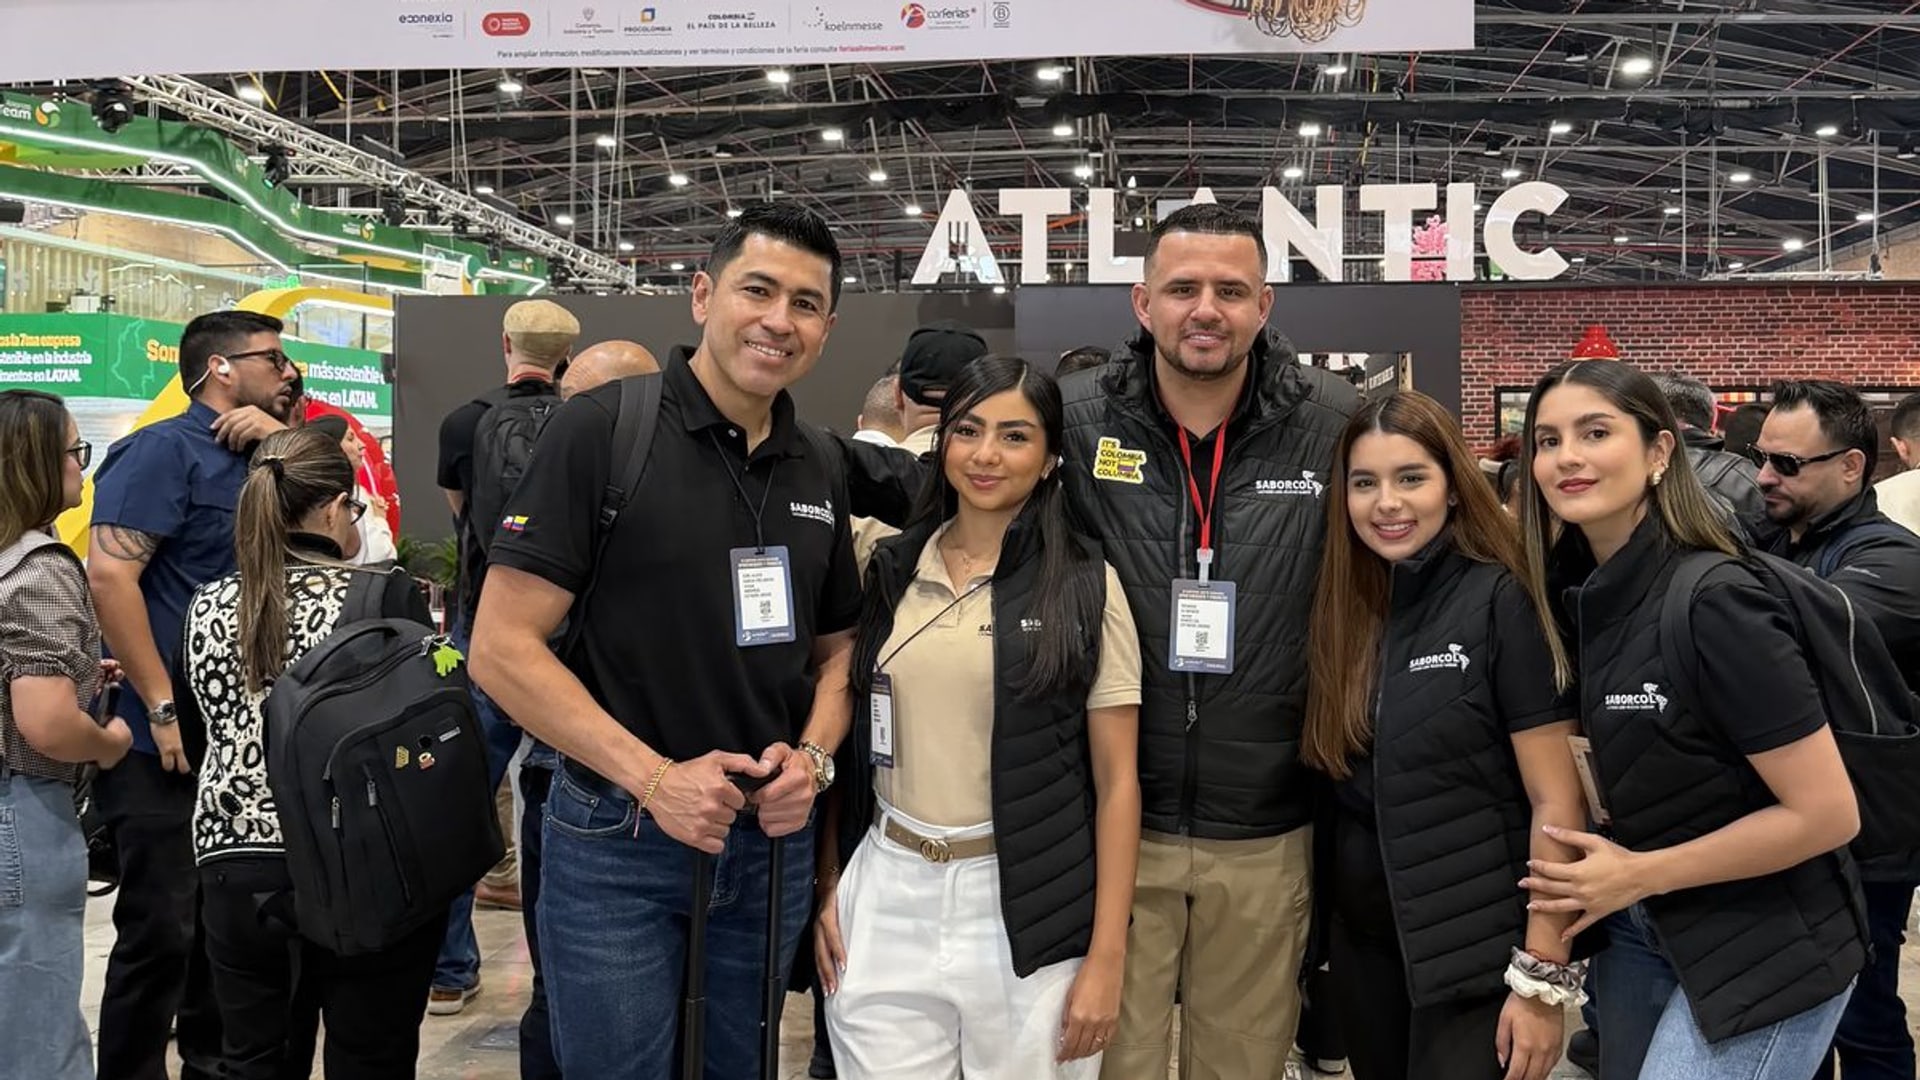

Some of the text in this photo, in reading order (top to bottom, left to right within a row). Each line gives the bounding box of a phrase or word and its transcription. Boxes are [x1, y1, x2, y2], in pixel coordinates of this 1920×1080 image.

[398, 12, 453, 24] econexia
[927, 7, 970, 19] corferias
[824, 20, 883, 31] koelnmesse
[911, 181, 1571, 285] ATLNTIC
[308, 360, 334, 380] más
[334, 364, 380, 384] sostenible
[1100, 450, 1143, 461] COLOMBIA
[1099, 459, 1117, 467] NOT
[1255, 479, 1314, 490] SABORCOL
[1409, 652, 1460, 668] SABORCOL
[1604, 694, 1656, 705] SABORCOL
